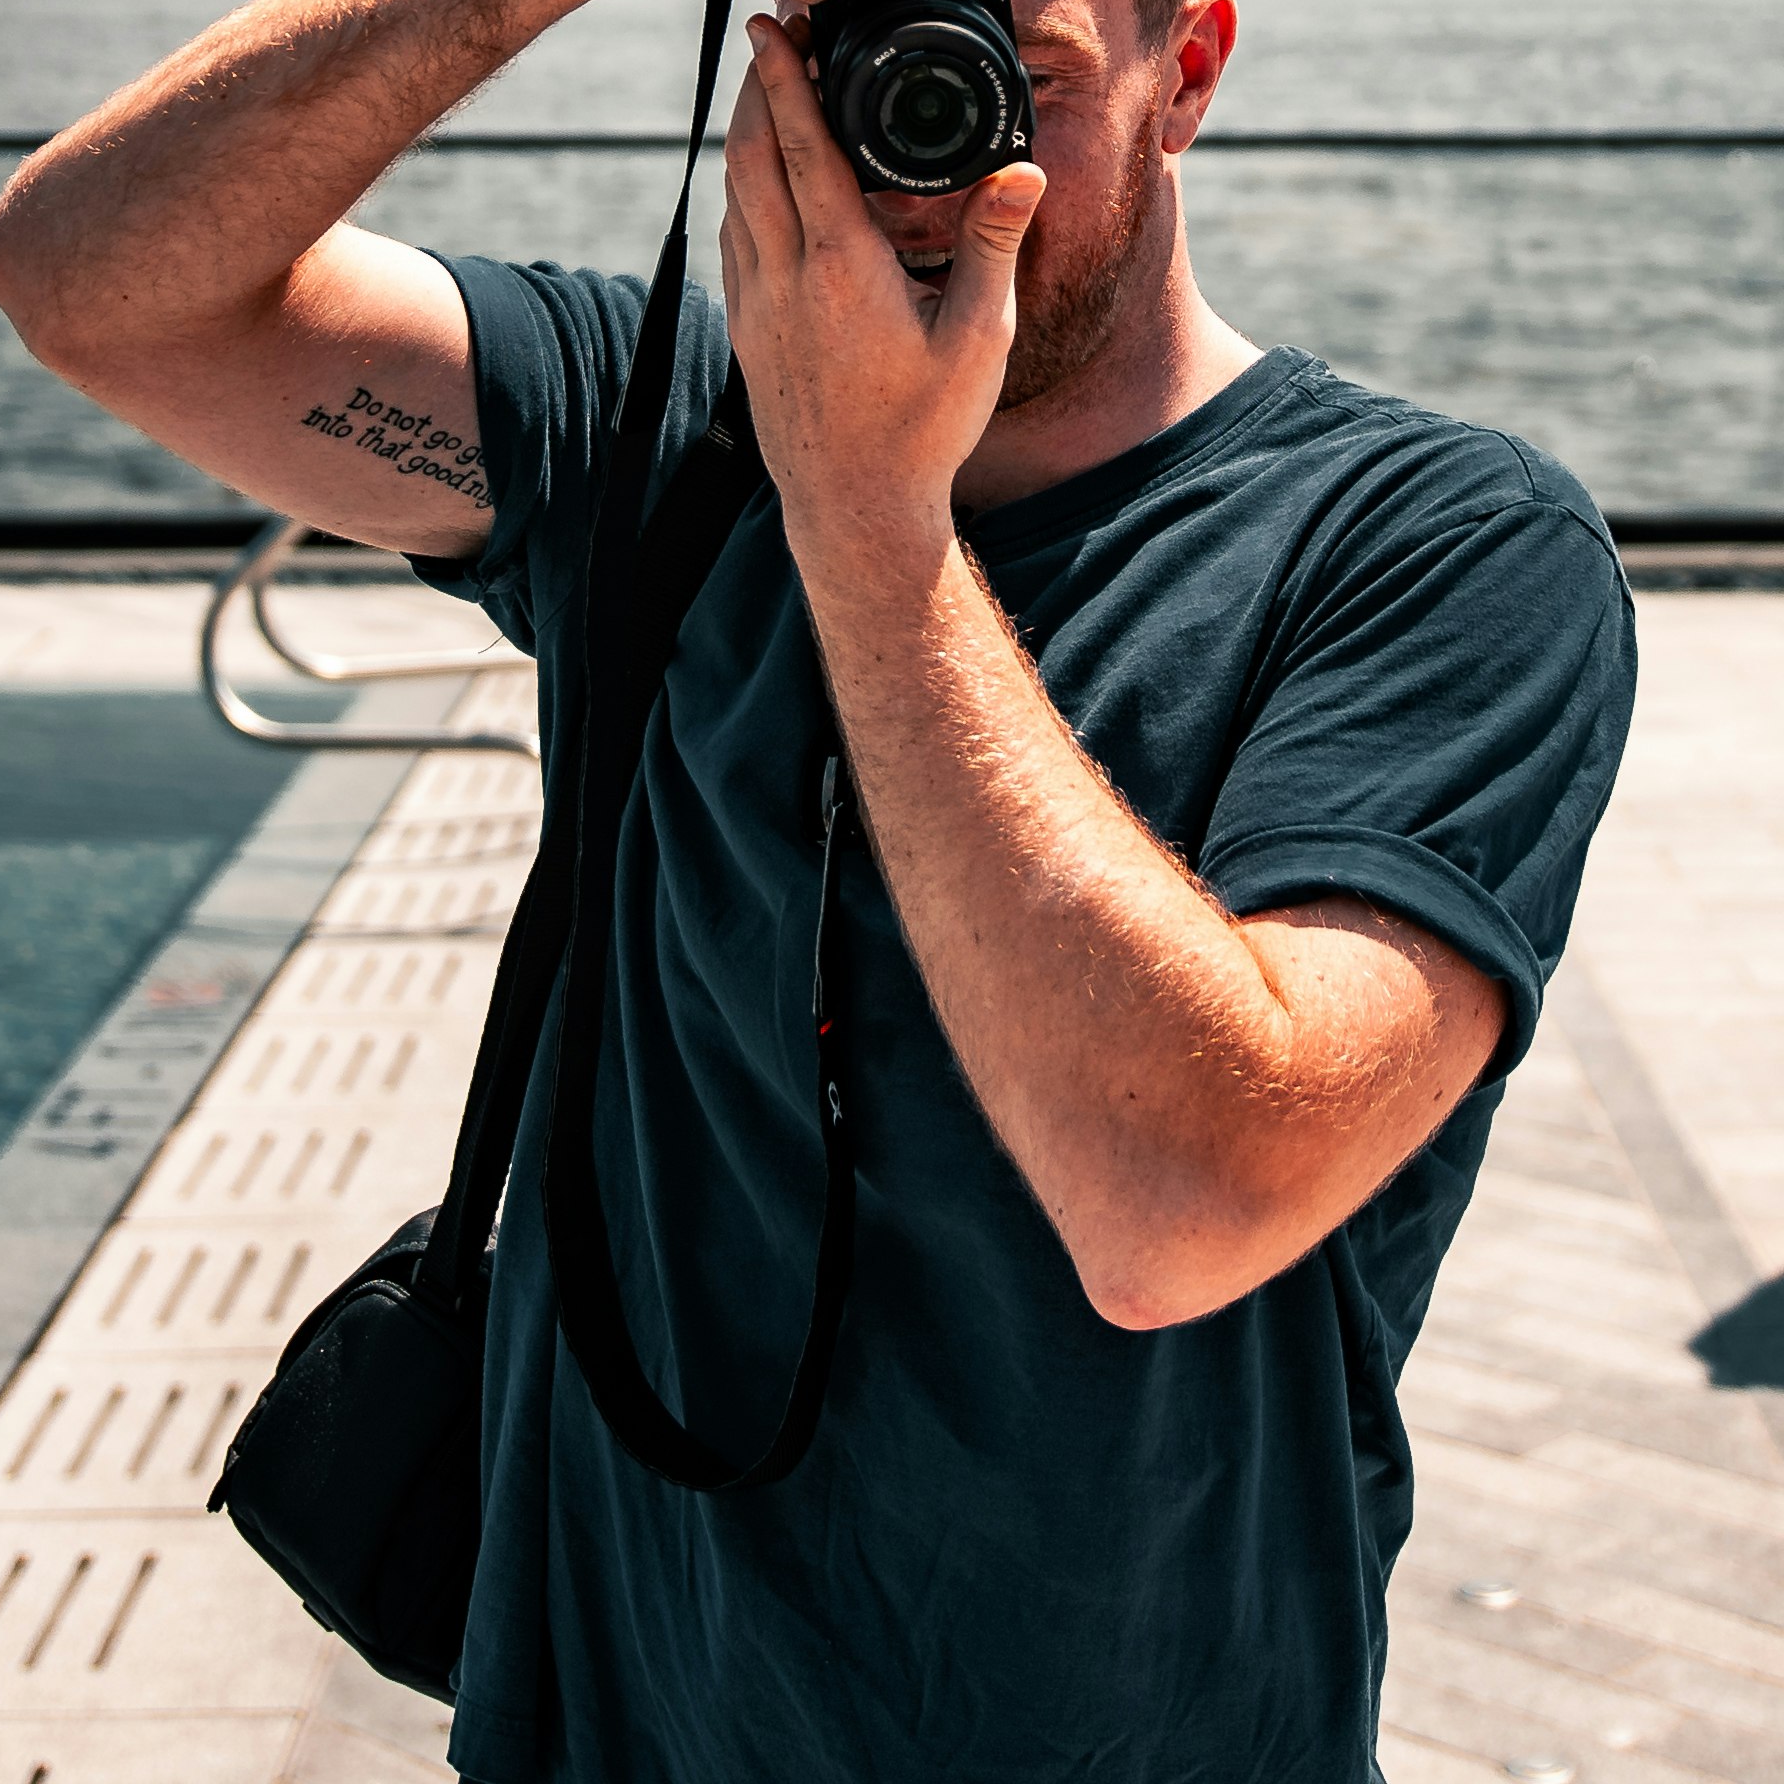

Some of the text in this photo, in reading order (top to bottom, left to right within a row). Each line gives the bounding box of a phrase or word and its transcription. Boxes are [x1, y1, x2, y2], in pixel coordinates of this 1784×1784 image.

[980, 59, 988, 68] E
[301, 406, 353, 438] into
[355, 425, 413, 461] that
[397, 455, 477, 490] good
[346, 387, 383, 416] Do
[381, 406, 432, 438] not
[423, 430, 462, 450] go
